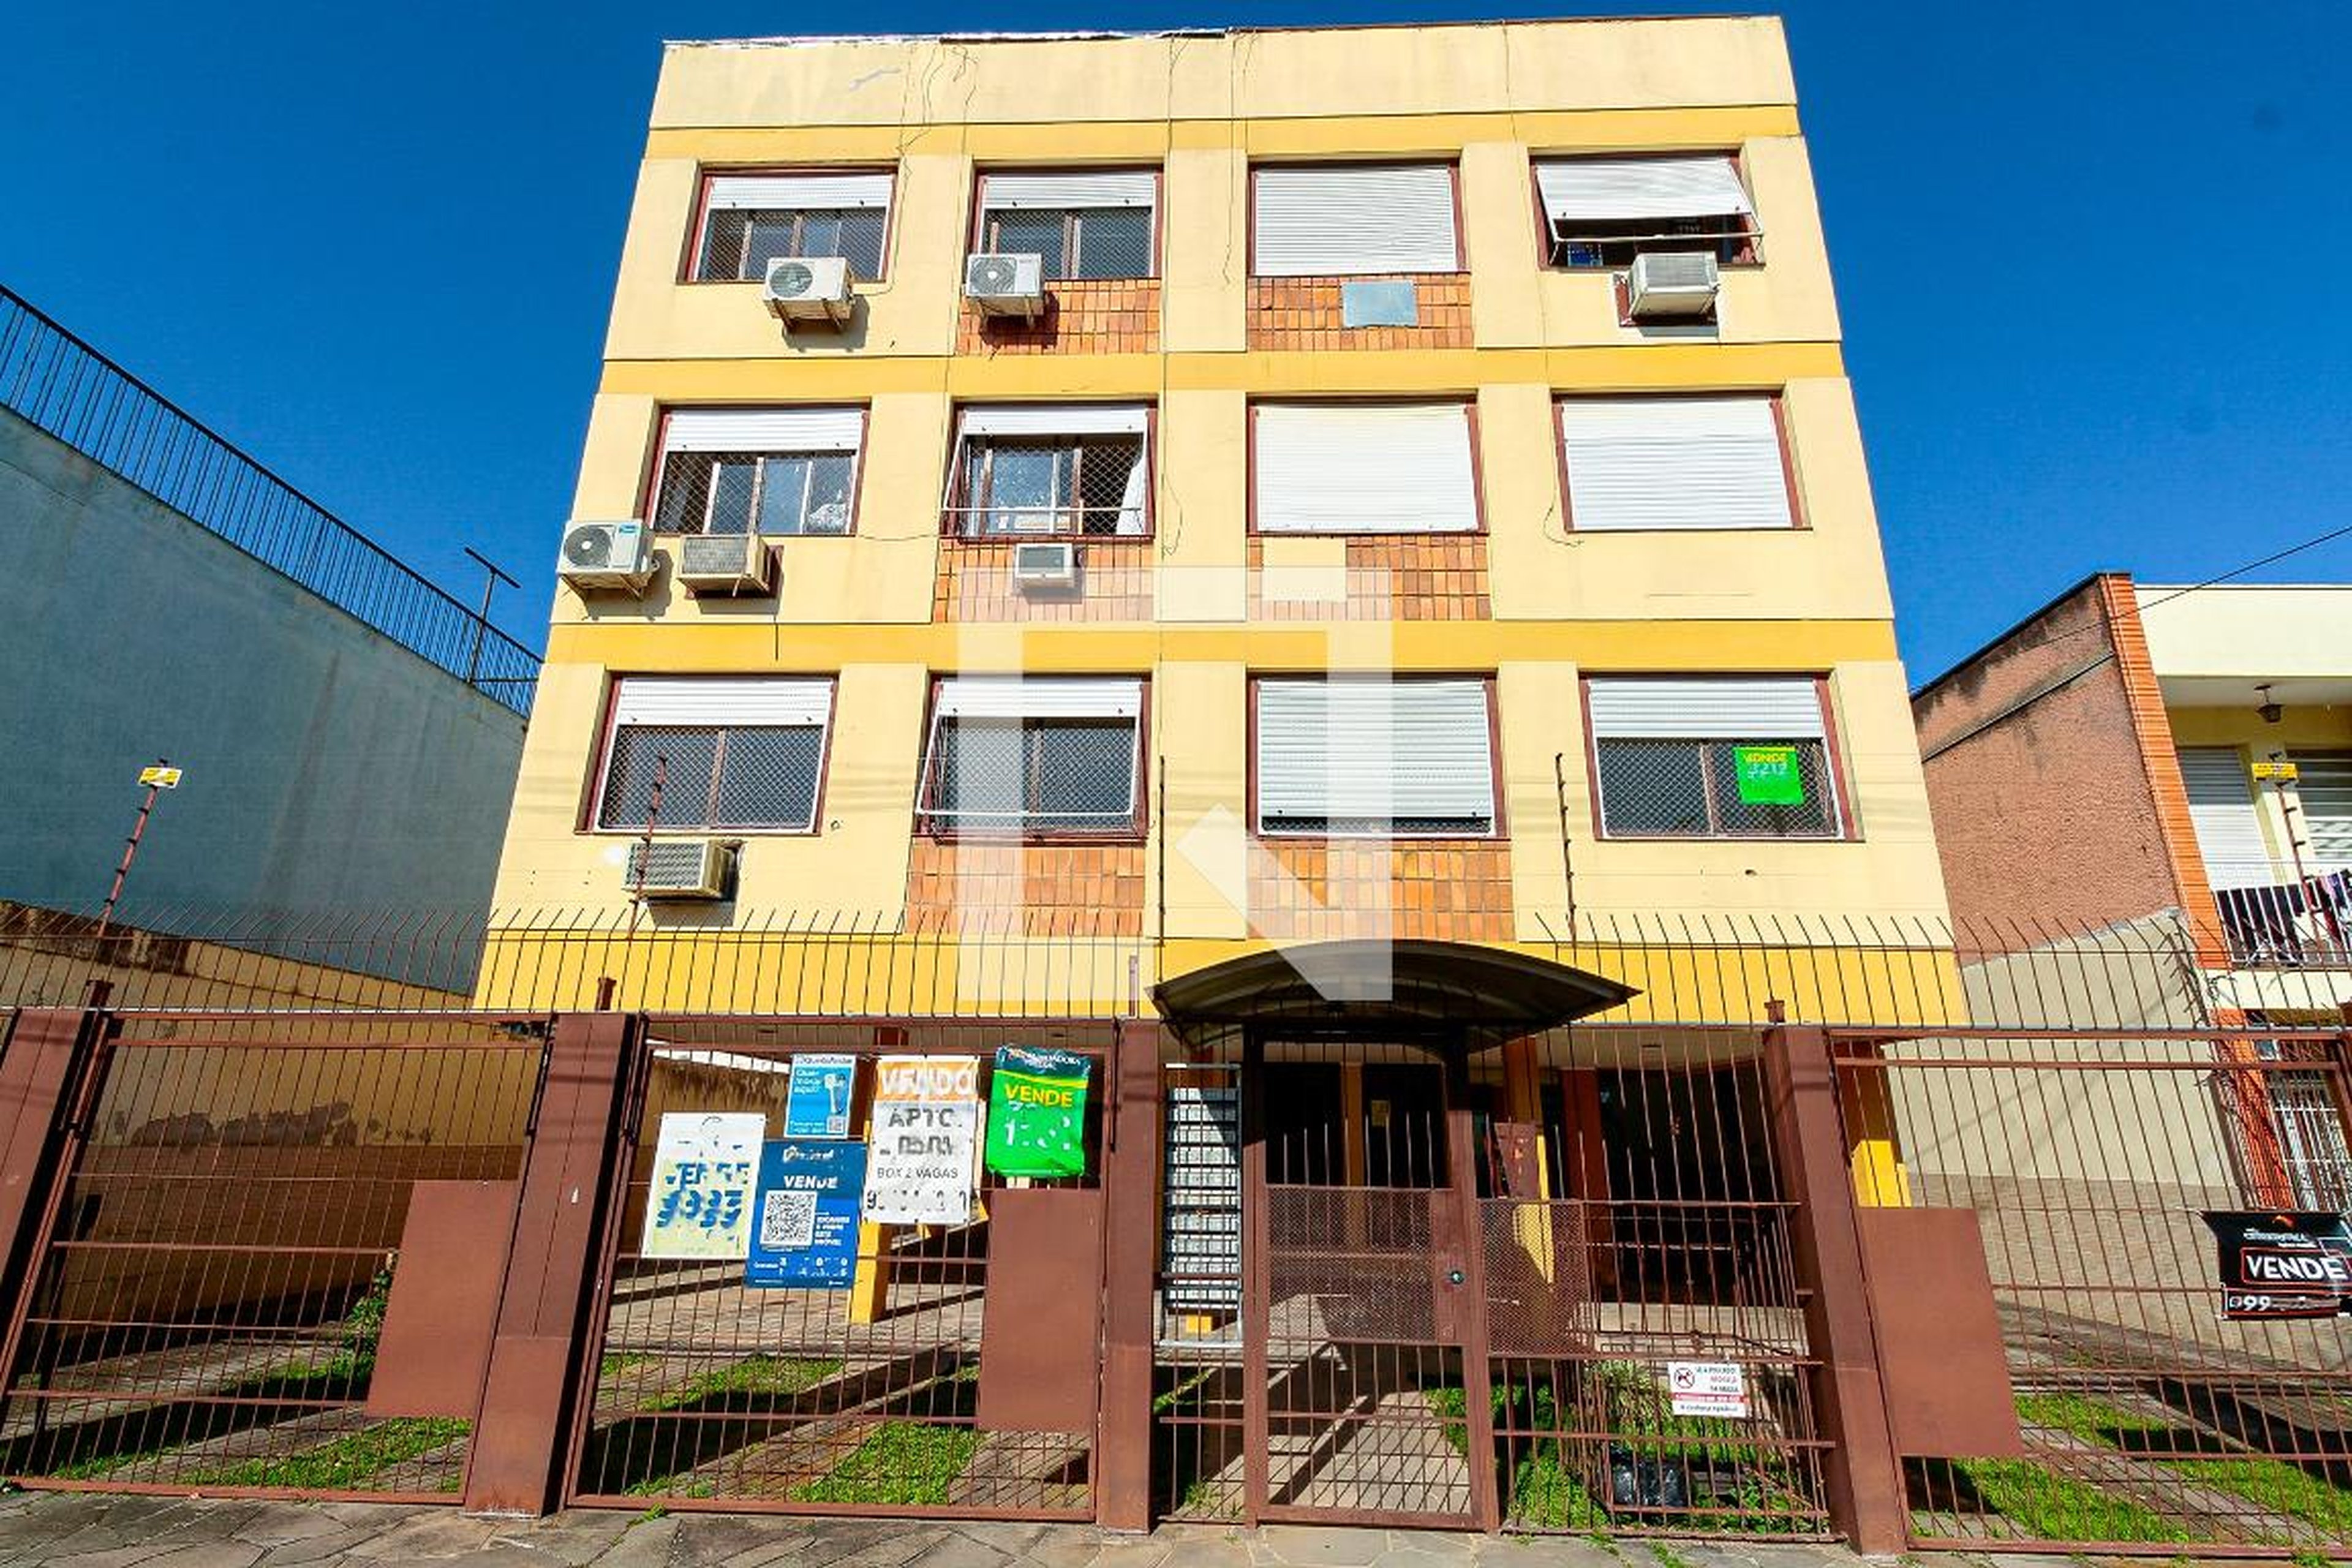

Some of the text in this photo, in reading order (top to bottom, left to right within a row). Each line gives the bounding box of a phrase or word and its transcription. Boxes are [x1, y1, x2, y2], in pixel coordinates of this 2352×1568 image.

[1005, 1084, 1073, 1107] VENDE
[916, 1167, 959, 1179] VAGAS
[2246, 1255, 2348, 1280] VENDE
